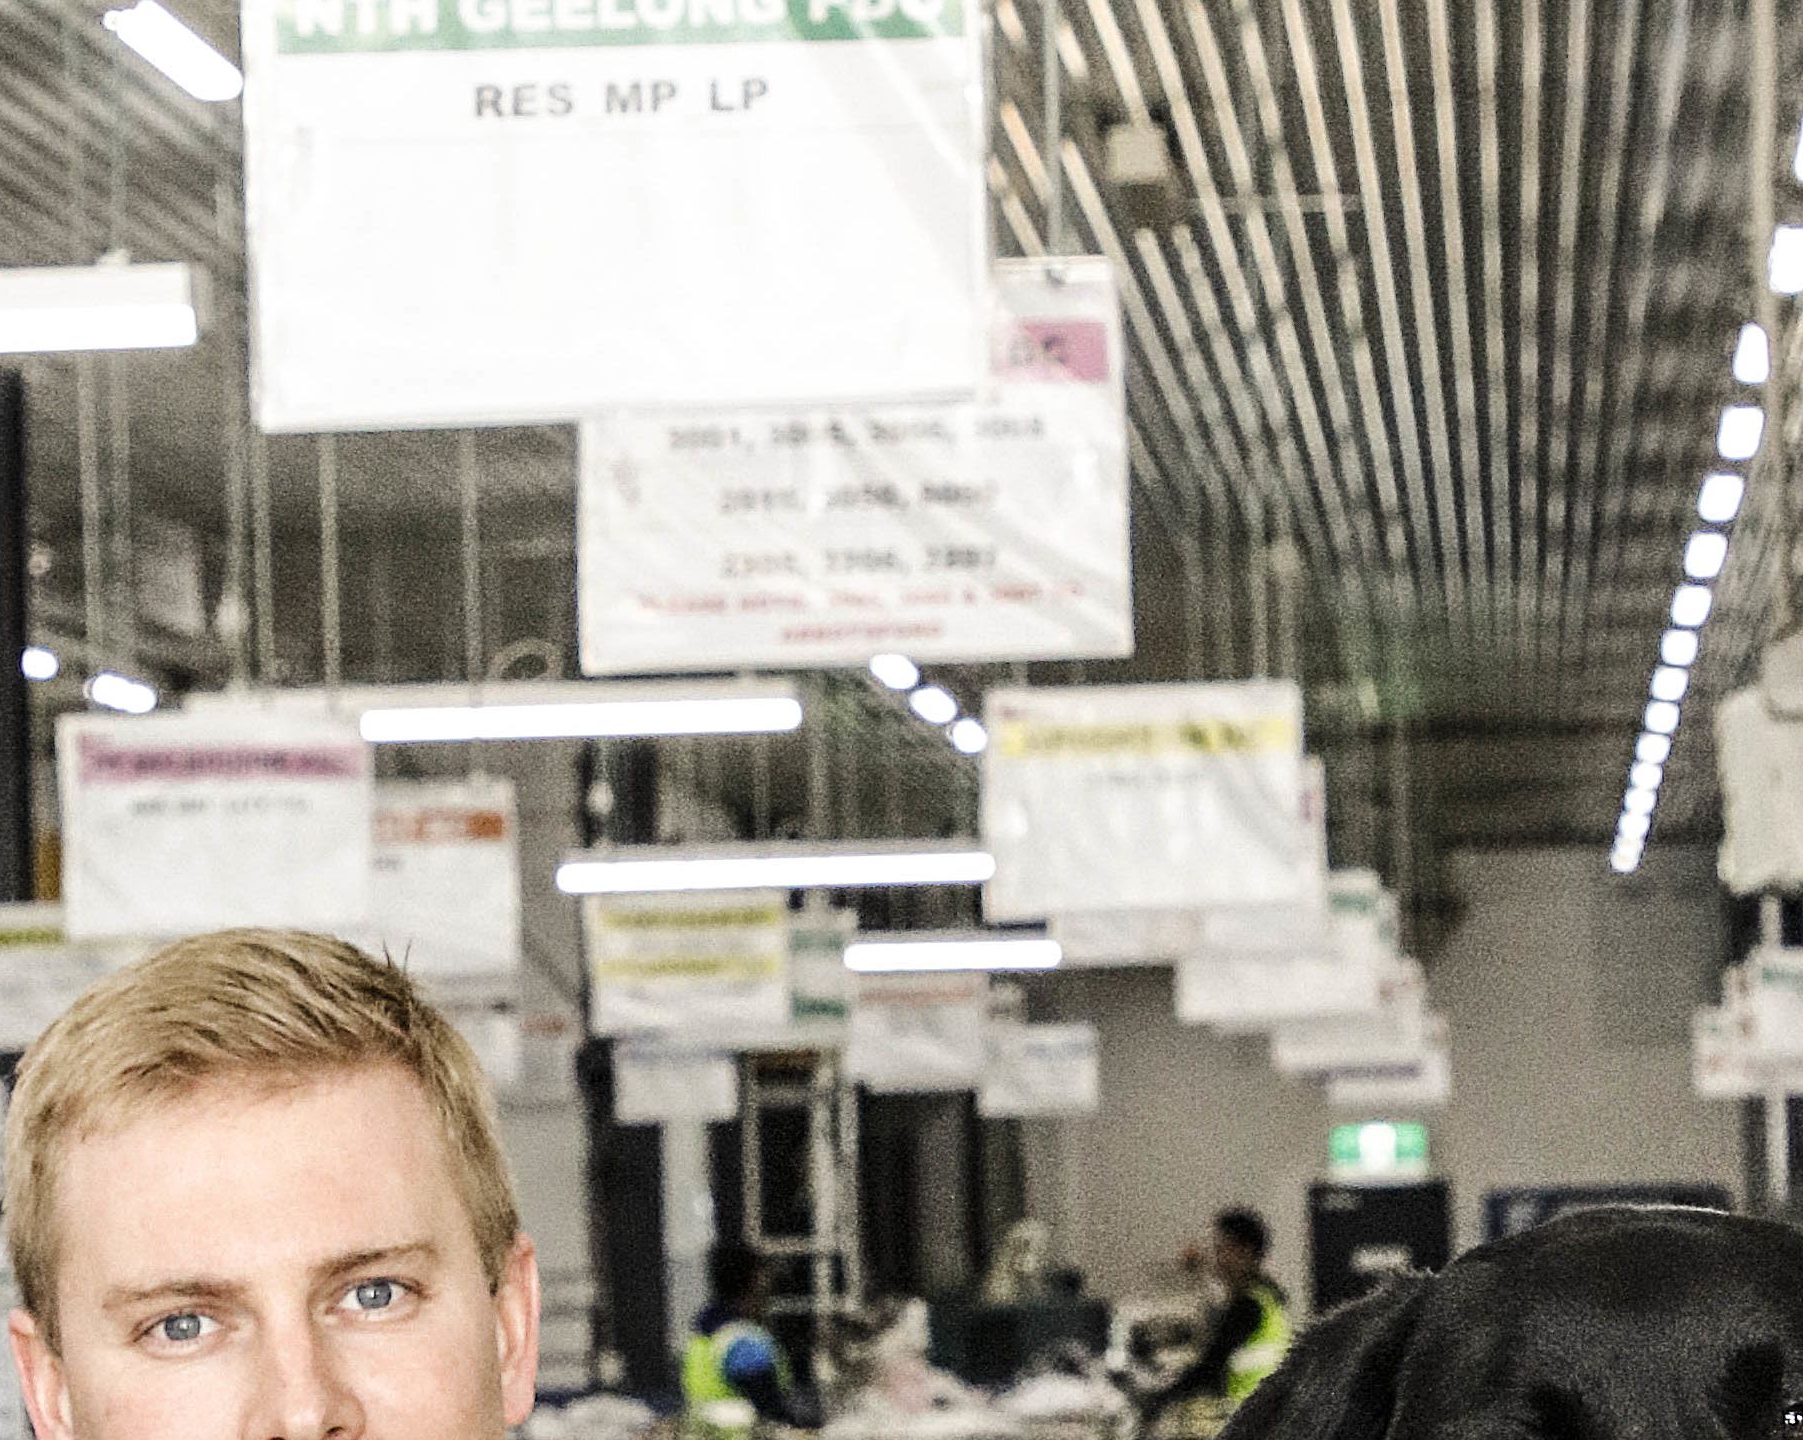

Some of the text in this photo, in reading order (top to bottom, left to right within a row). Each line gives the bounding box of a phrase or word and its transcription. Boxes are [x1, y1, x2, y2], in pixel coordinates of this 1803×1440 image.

[474, 79, 770, 118] RES MP LP
